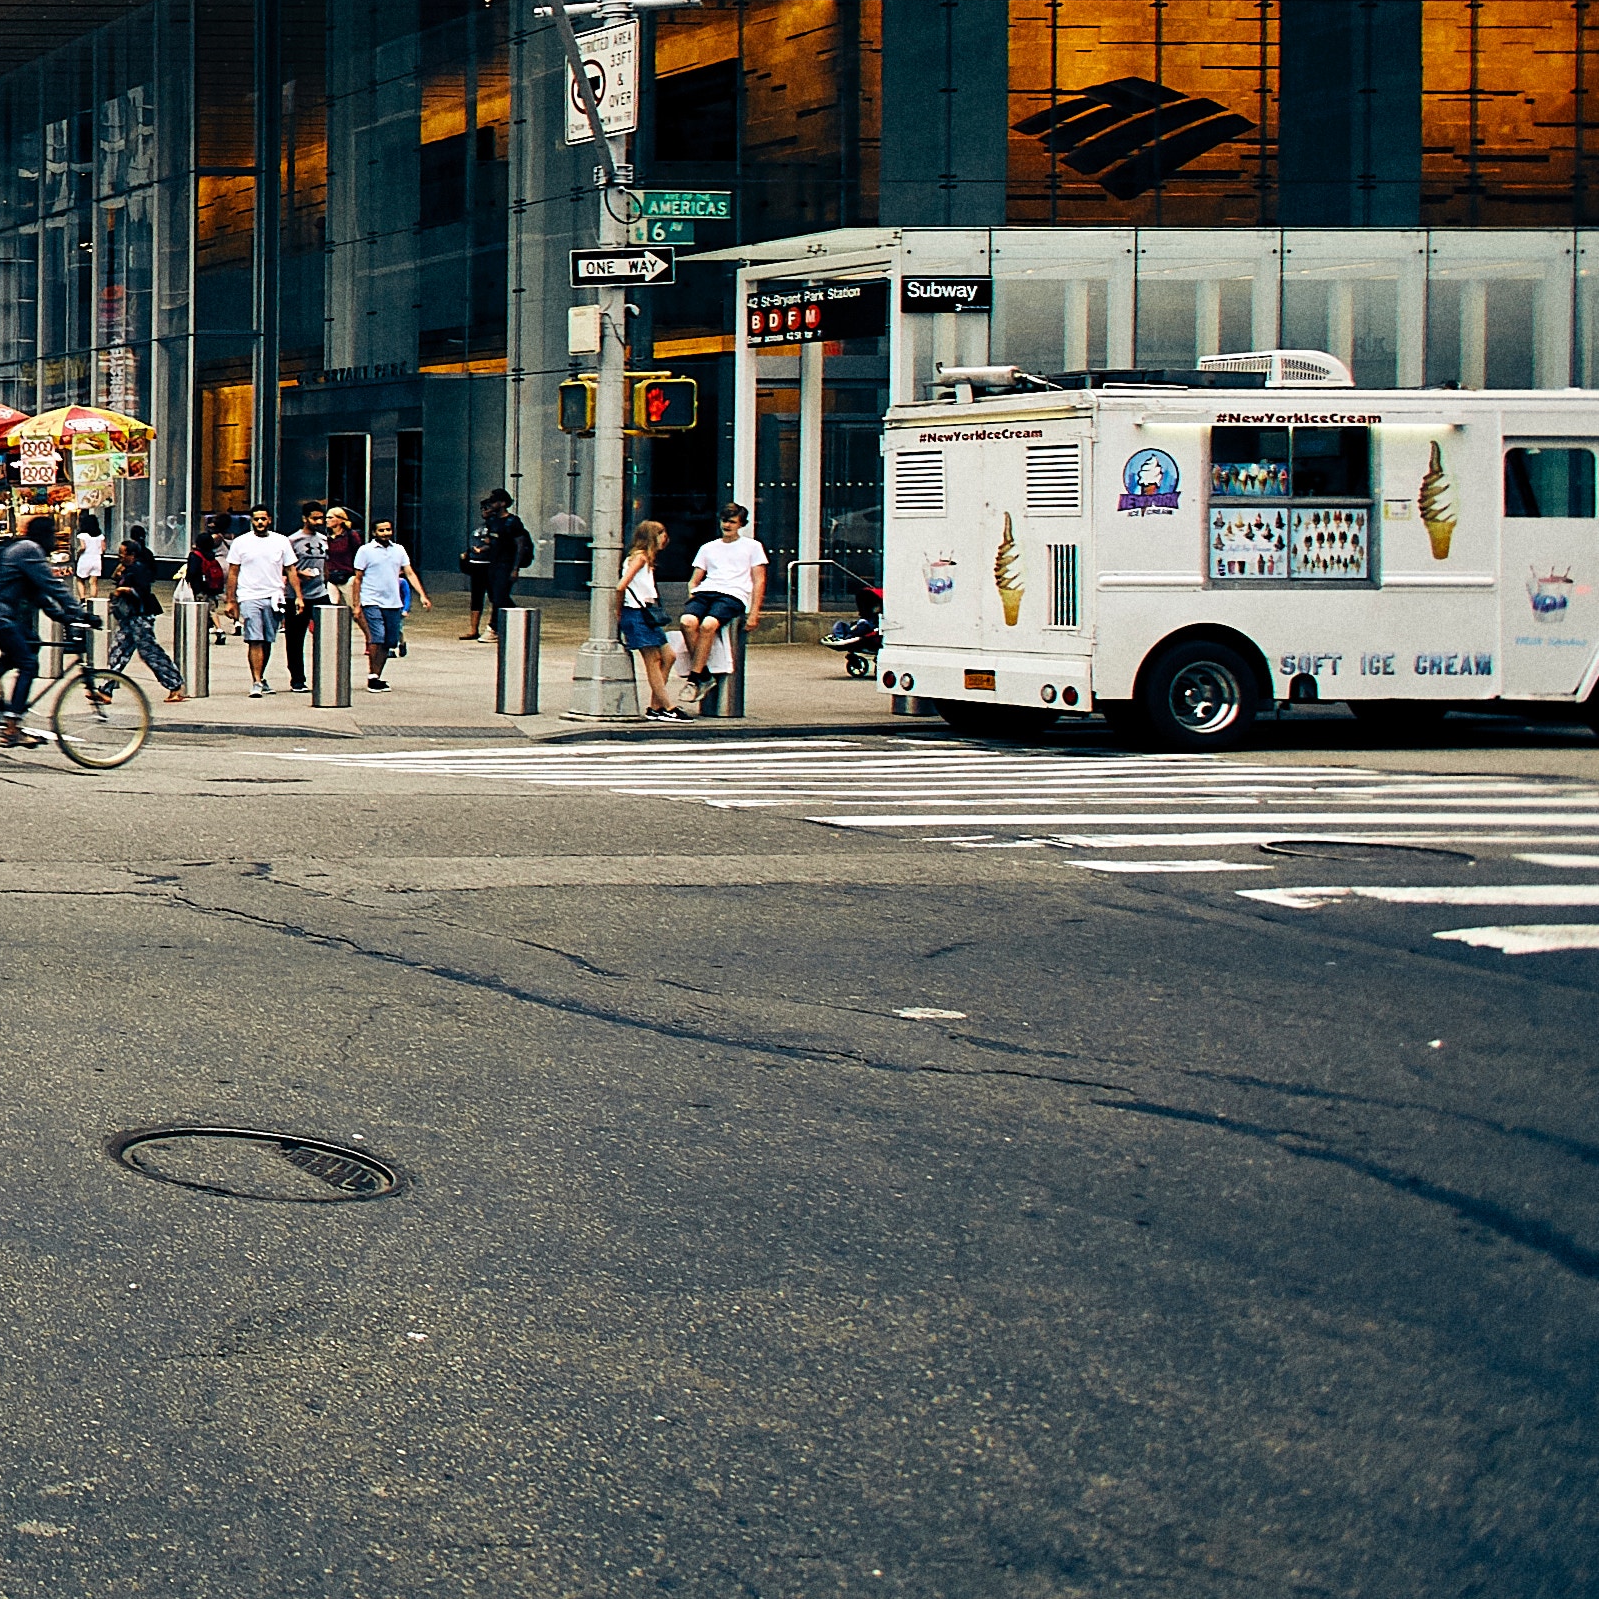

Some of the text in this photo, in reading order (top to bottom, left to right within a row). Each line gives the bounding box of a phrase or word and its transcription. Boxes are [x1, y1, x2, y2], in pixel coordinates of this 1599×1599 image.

[580, 31, 632, 54] TRICTED AREA
[610, 50, 632, 68] 33FT
[610, 91, 632, 108] OVER
[648, 201, 728, 215] AMERICAS
[652, 221, 683, 241] 6 AV
[586, 260, 658, 275] ONE WAY
[804, 290, 825, 303] Park
[827, 287, 861, 300] Station
[907, 281, 978, 301] Subway
[752, 309, 816, 330] B D F M
[1216, 413, 1382, 423] #NewYorkIceCream
[919, 428, 1043, 443] #NewYorkIceCream
[1280, 652, 1493, 676] SOFT ICE CREAM
